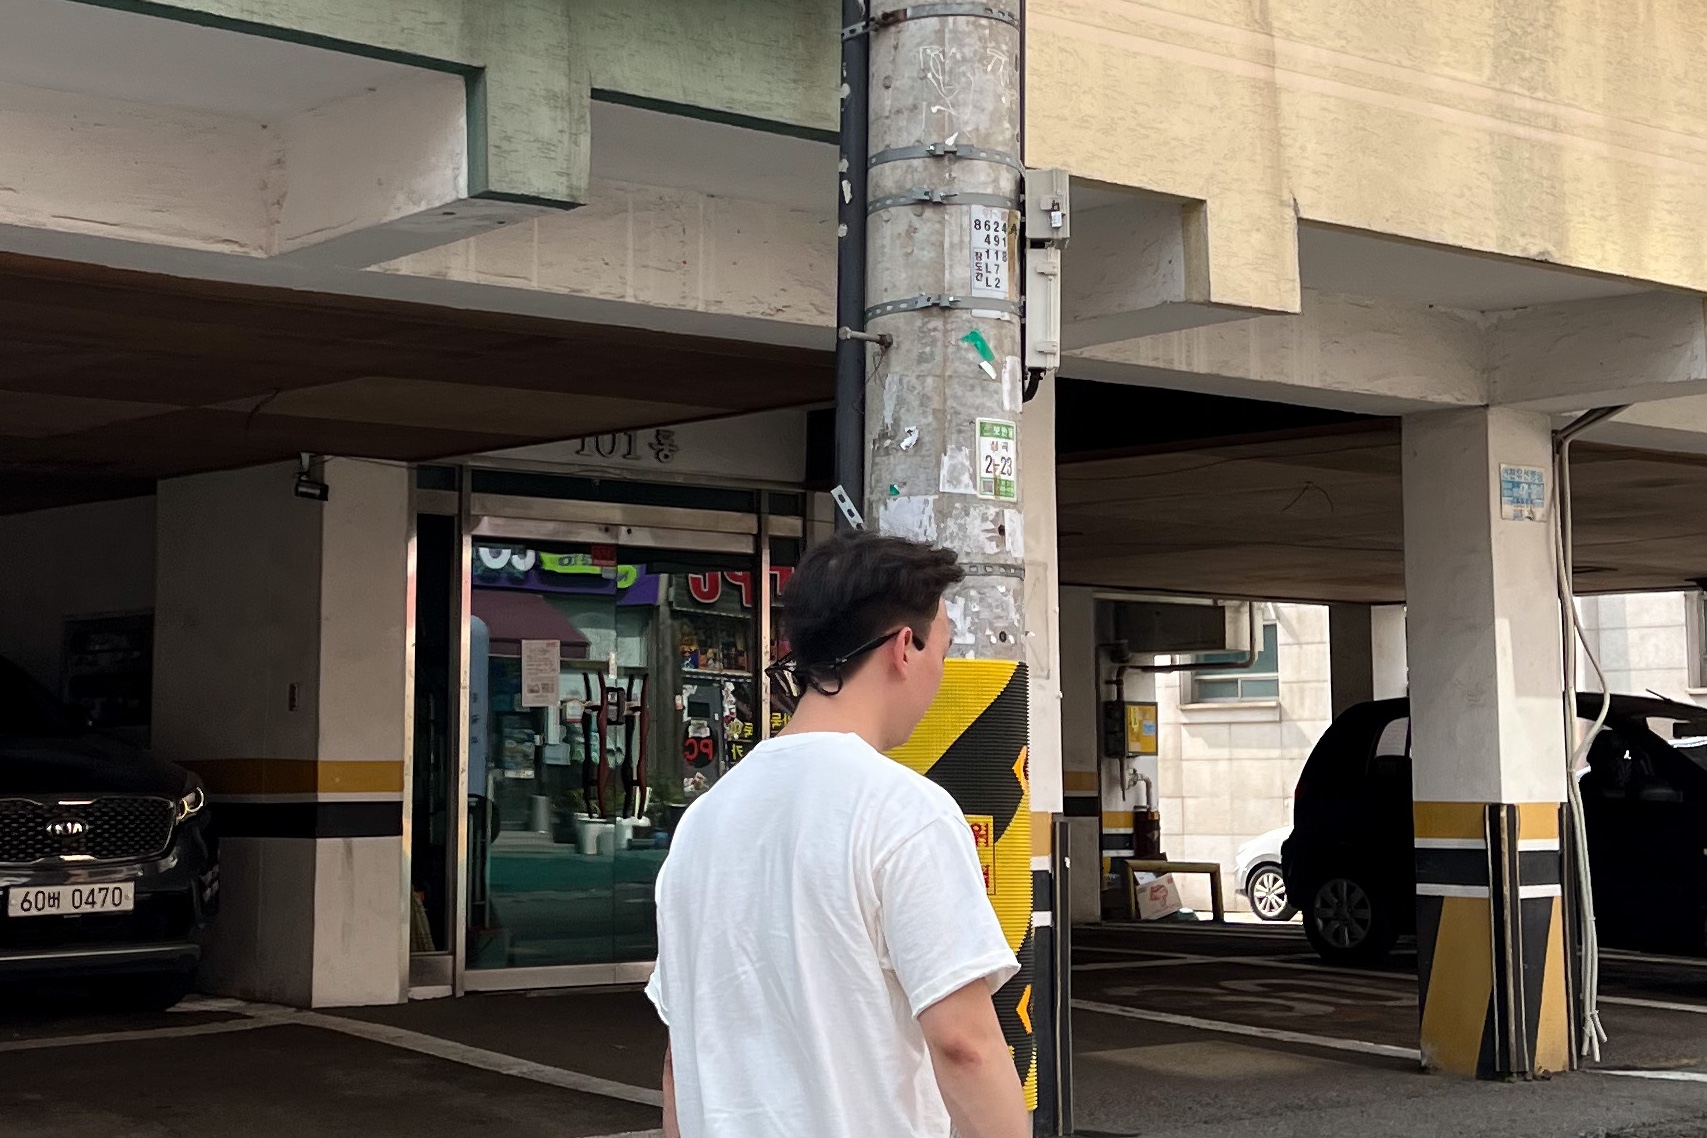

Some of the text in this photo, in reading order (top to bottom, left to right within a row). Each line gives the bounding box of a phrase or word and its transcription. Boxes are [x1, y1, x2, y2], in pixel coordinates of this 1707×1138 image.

[984, 233, 1007, 248] 491
[985, 276, 1001, 289] L2
[985, 454, 1013, 477] 2-23
[20, 886, 123, 912] 60버 0470
